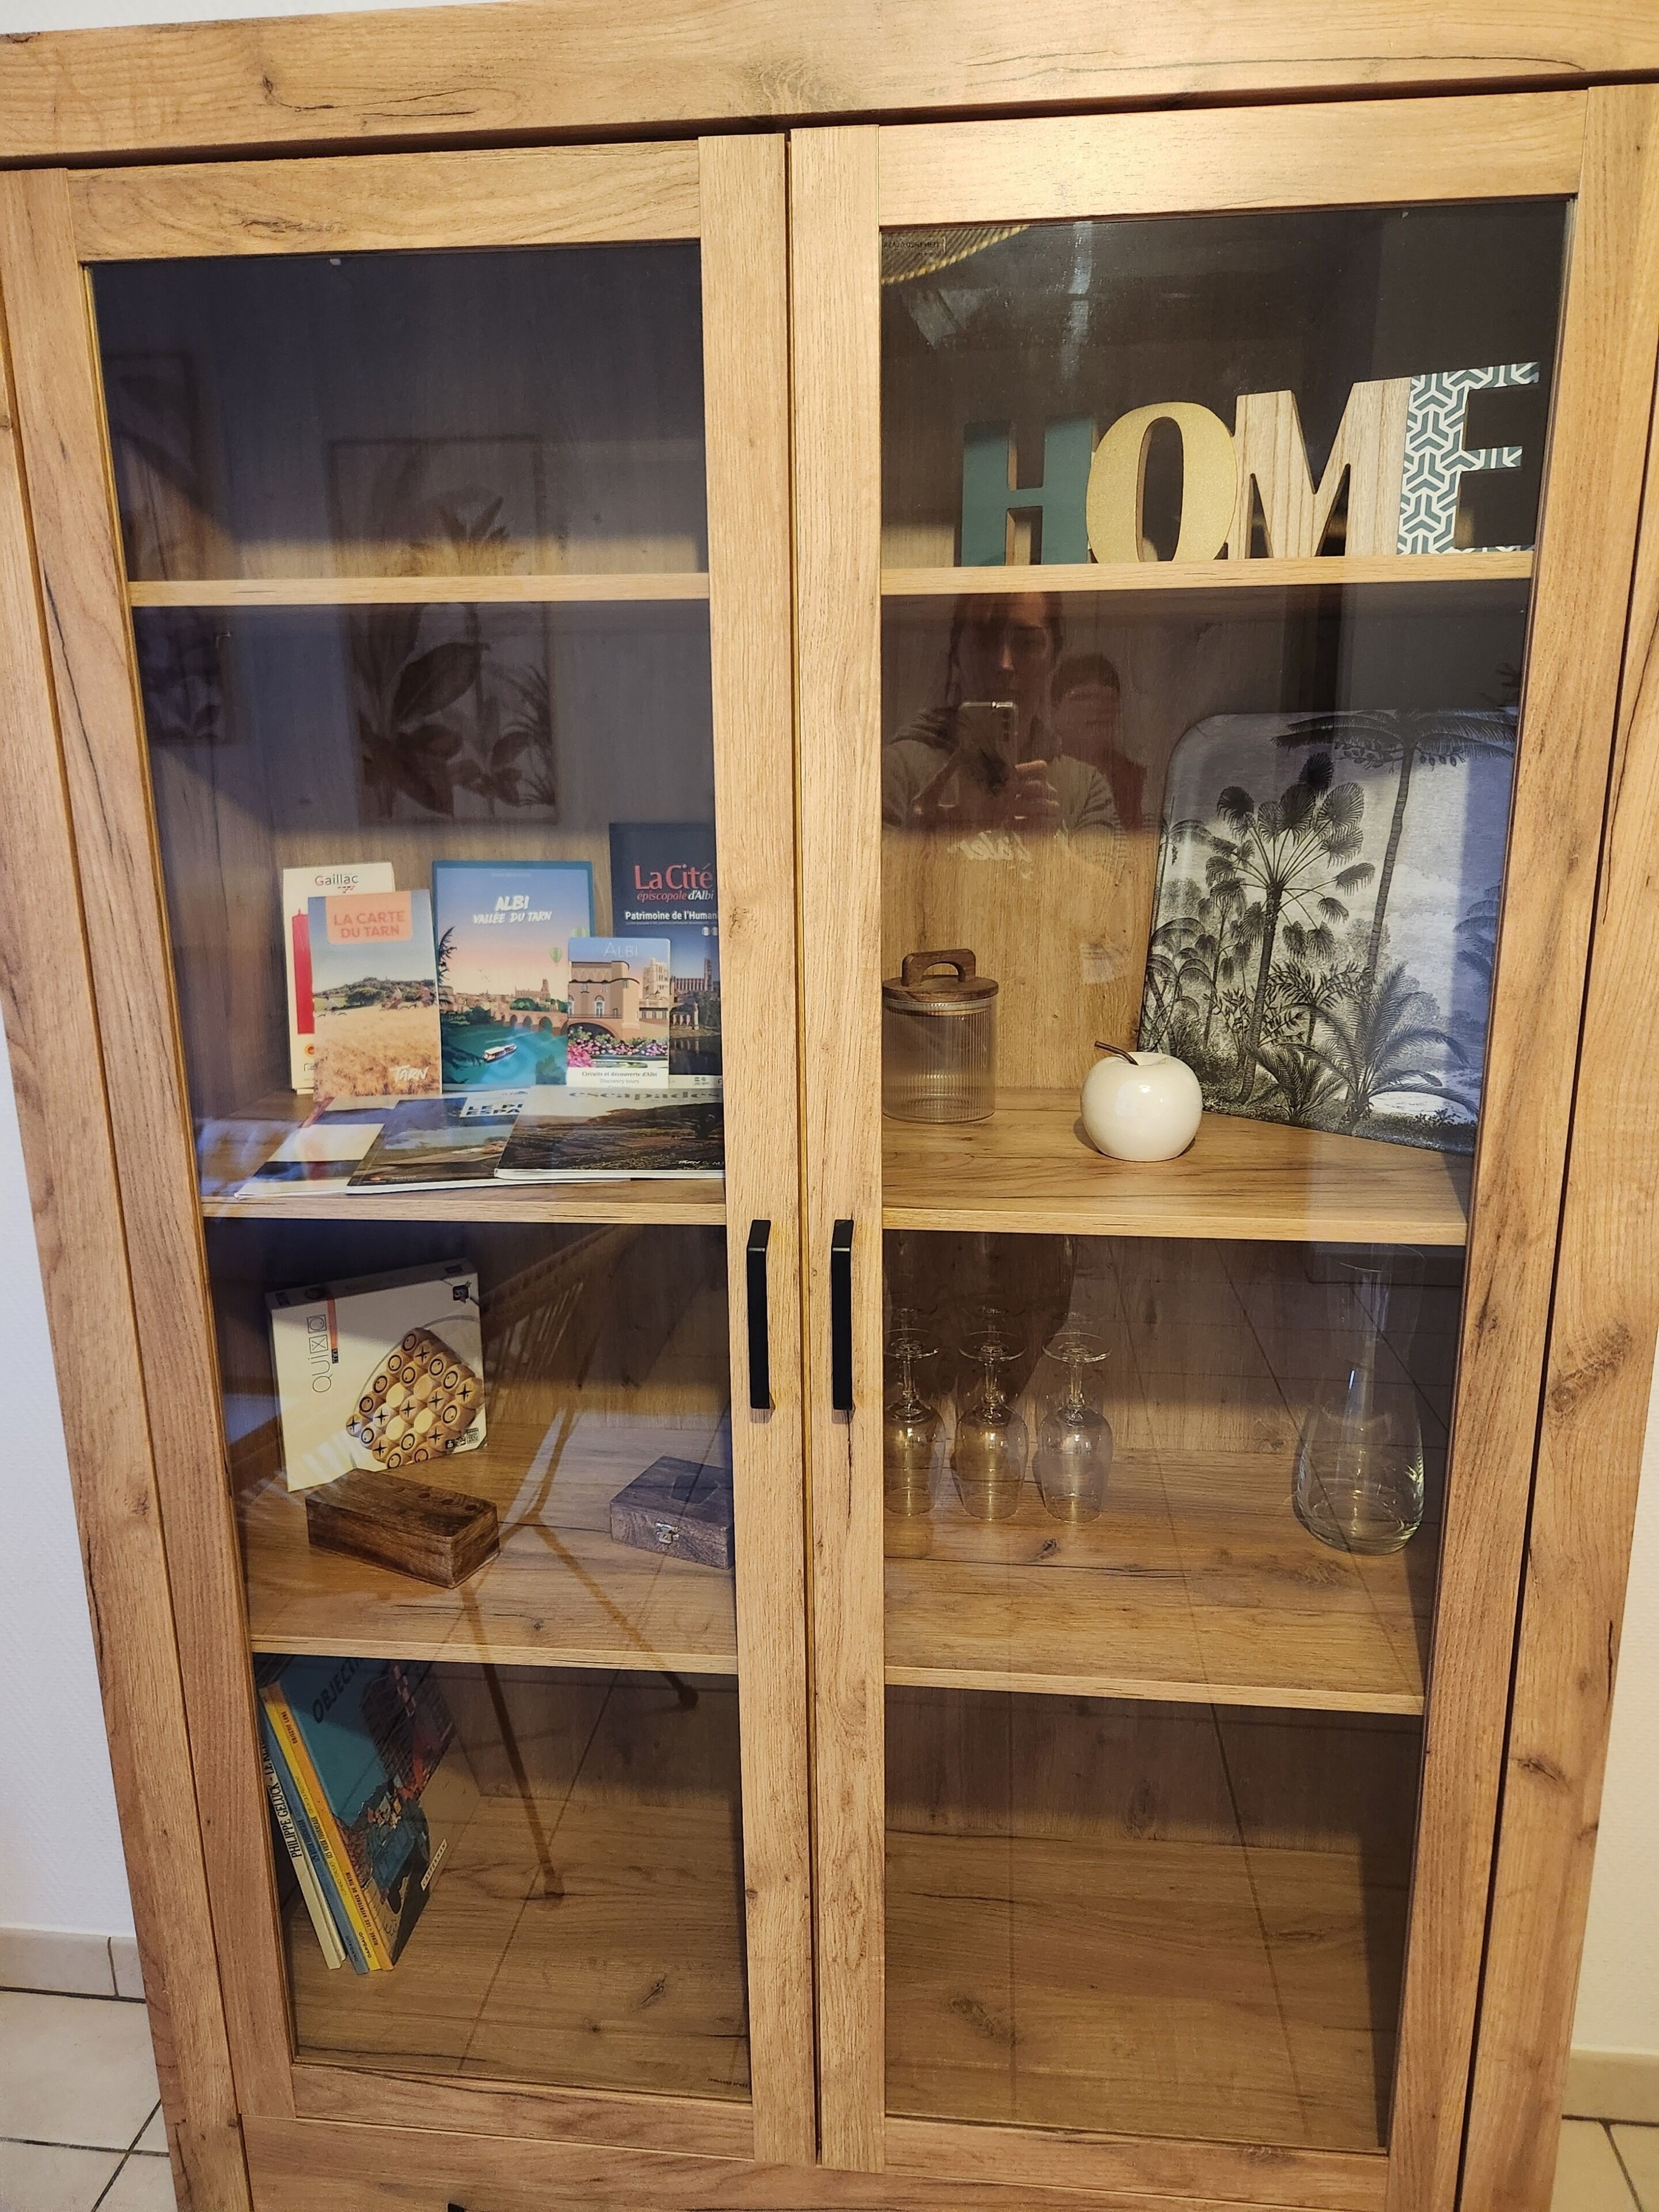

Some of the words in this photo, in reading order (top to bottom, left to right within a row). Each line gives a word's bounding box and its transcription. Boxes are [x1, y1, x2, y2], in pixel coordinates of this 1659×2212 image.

[960, 361, 1540, 568] HOME
[315, 873, 359, 886] Gaillac
[634, 865, 663, 890] La
[666, 863, 714, 890] Cité
[495, 895, 530, 912] ALBI
[637, 891, 687, 903] épiscopale
[688, 889, 714, 901] d'Albi
[334, 913, 353, 926] LA
[356, 910, 406, 925] CARTE
[474, 912, 506, 925] VALLÉE
[510, 912, 525, 923] DU
[528, 911, 552, 922] TARN
[625, 911, 670, 921] Patrimoine
[672, 911, 682, 920] de
[684, 911, 718, 920] l'Human
[340, 927, 360, 938] DU
[363, 925, 400, 937] TARN
[389, 1065, 429, 1083] TARN
[267, 1781, 289, 1819] GELUCK
[279, 1817, 302, 1859] PHILIPPE
[422, 1843, 446, 1887] CASTERMAN
[344, 1871, 354, 1886] TINTIN
[354, 1893, 368, 1918] AVENTURES
[358, 1931, 372, 1959] DARGAUD
